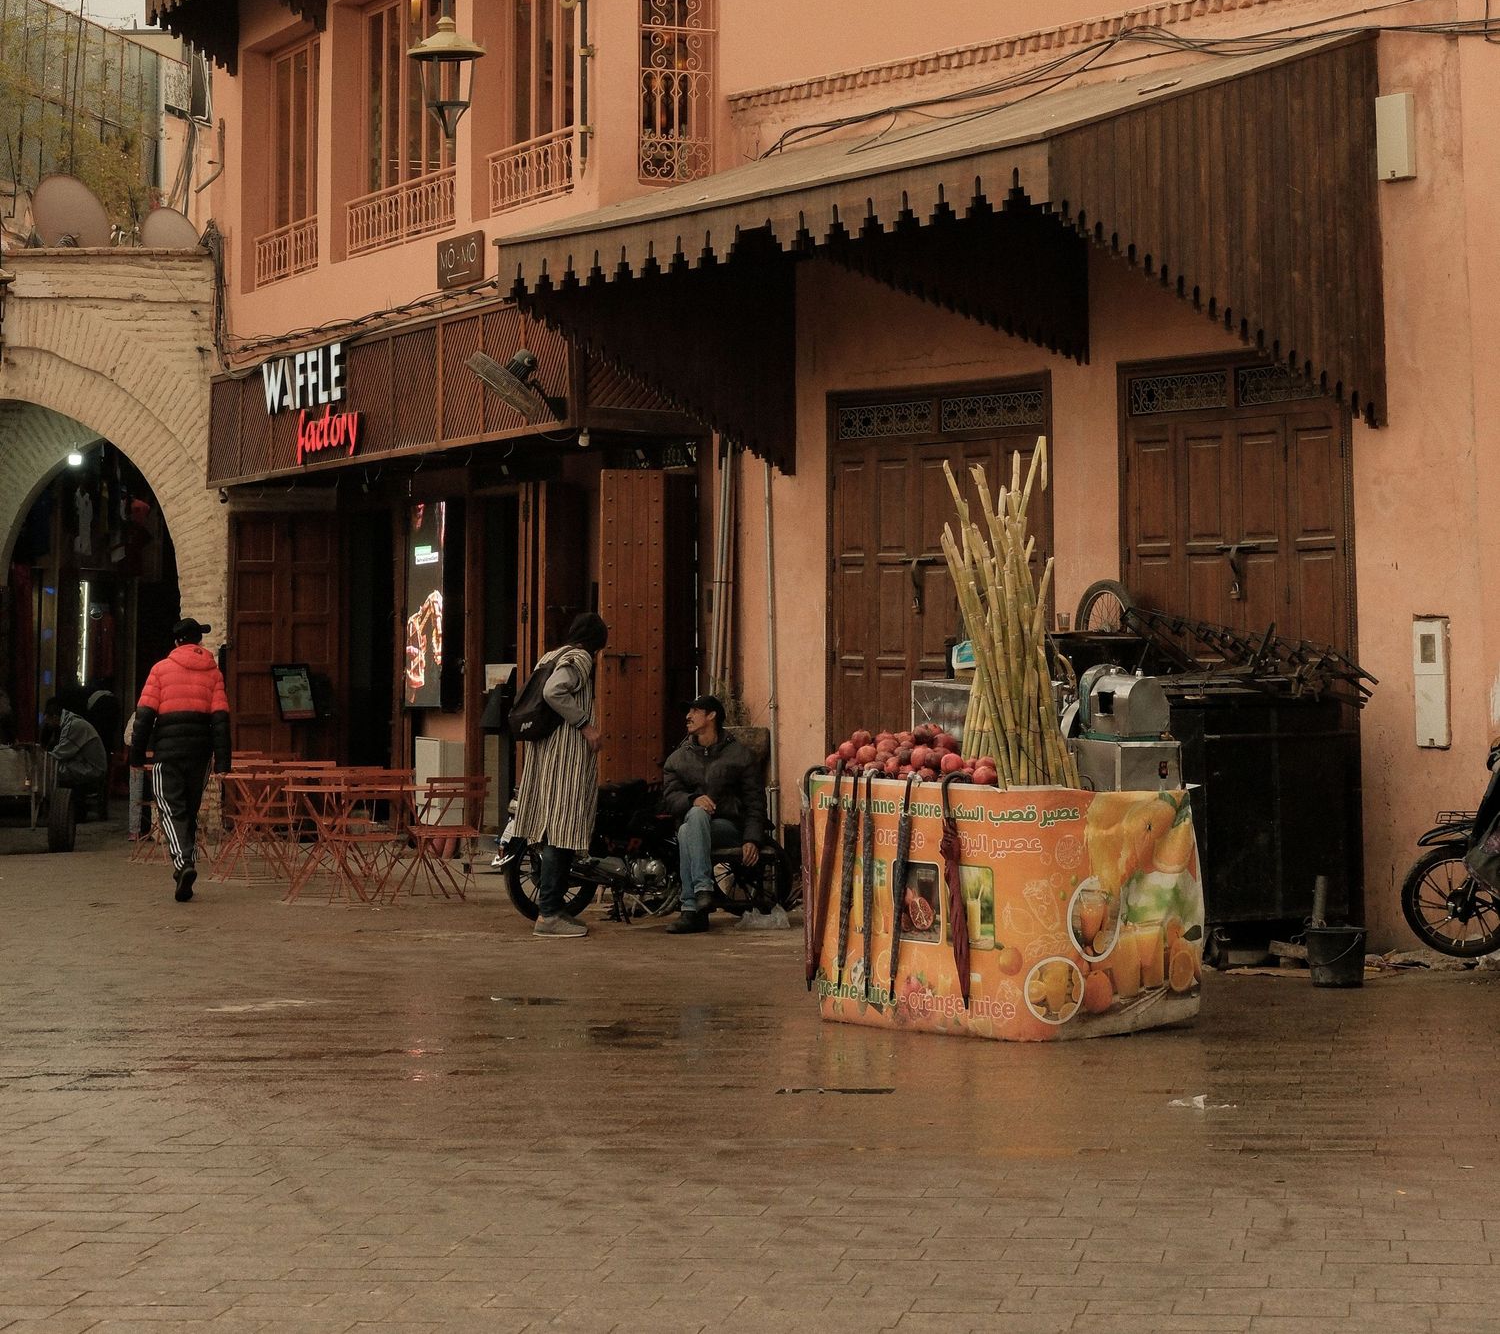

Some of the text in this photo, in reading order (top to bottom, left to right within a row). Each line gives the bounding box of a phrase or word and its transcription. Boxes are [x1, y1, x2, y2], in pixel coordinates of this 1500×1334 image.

[262, 343, 342, 415] WAFFLE
[818, 791, 838, 811] Ju
[859, 797, 896, 815] cnne
[910, 800, 942, 818] sucre
[988, 804, 1038, 827] قصب
[1039, 807, 1080, 829] عصير
[989, 835, 1043, 859] عصير
[908, 991, 965, 1019] orange
[967, 995, 1017, 1020] juice
